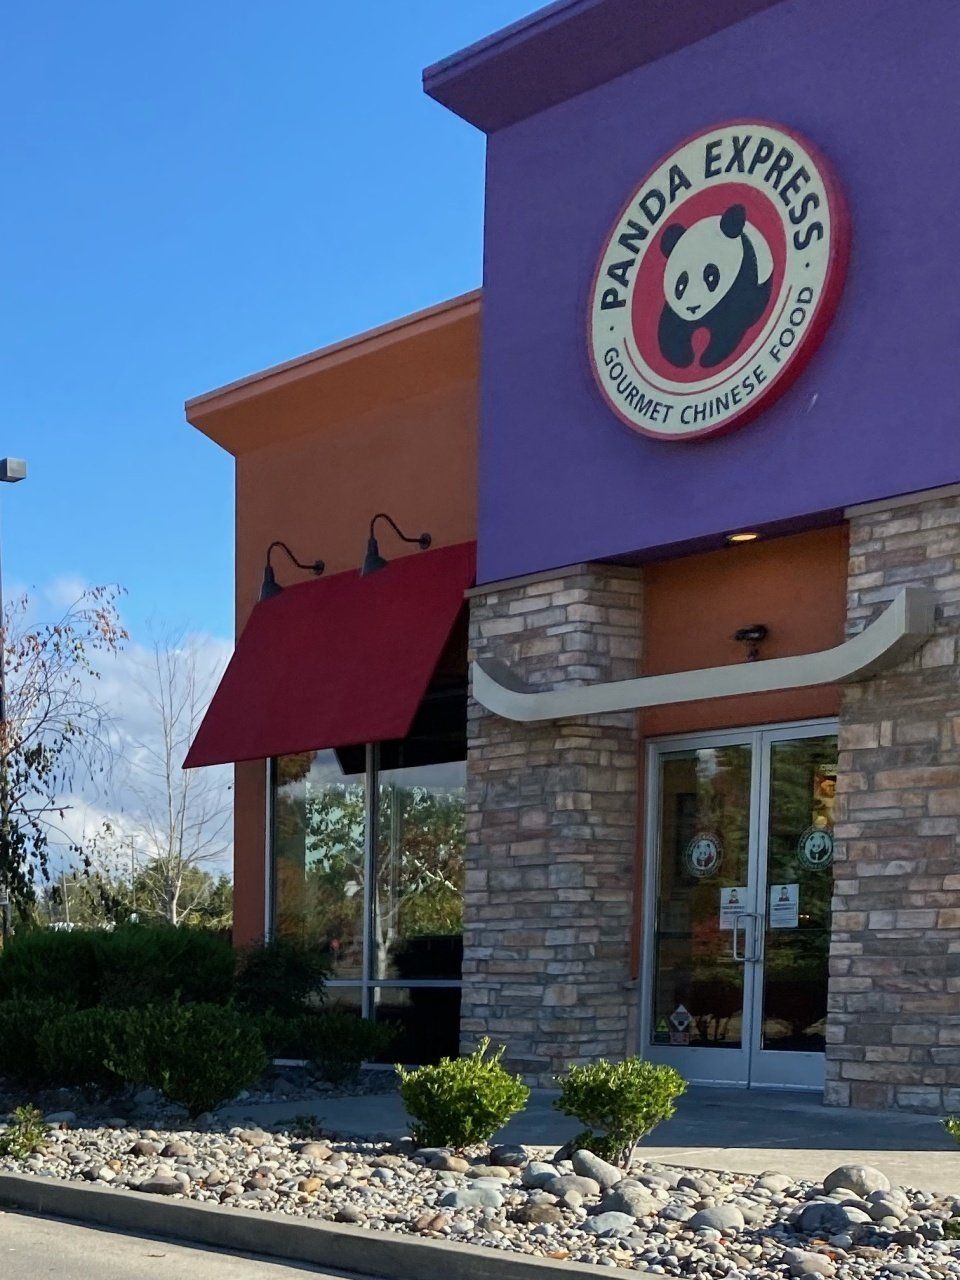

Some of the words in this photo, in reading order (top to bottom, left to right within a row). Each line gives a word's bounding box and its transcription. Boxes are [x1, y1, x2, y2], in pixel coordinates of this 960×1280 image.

[601, 164, 692, 310] PANDA
[704, 135, 824, 251] EXPRESS
[604, 347, 673, 423] GOURMET
[680, 365, 767, 425] CHINESE
[769, 286, 814, 363] FOOD
